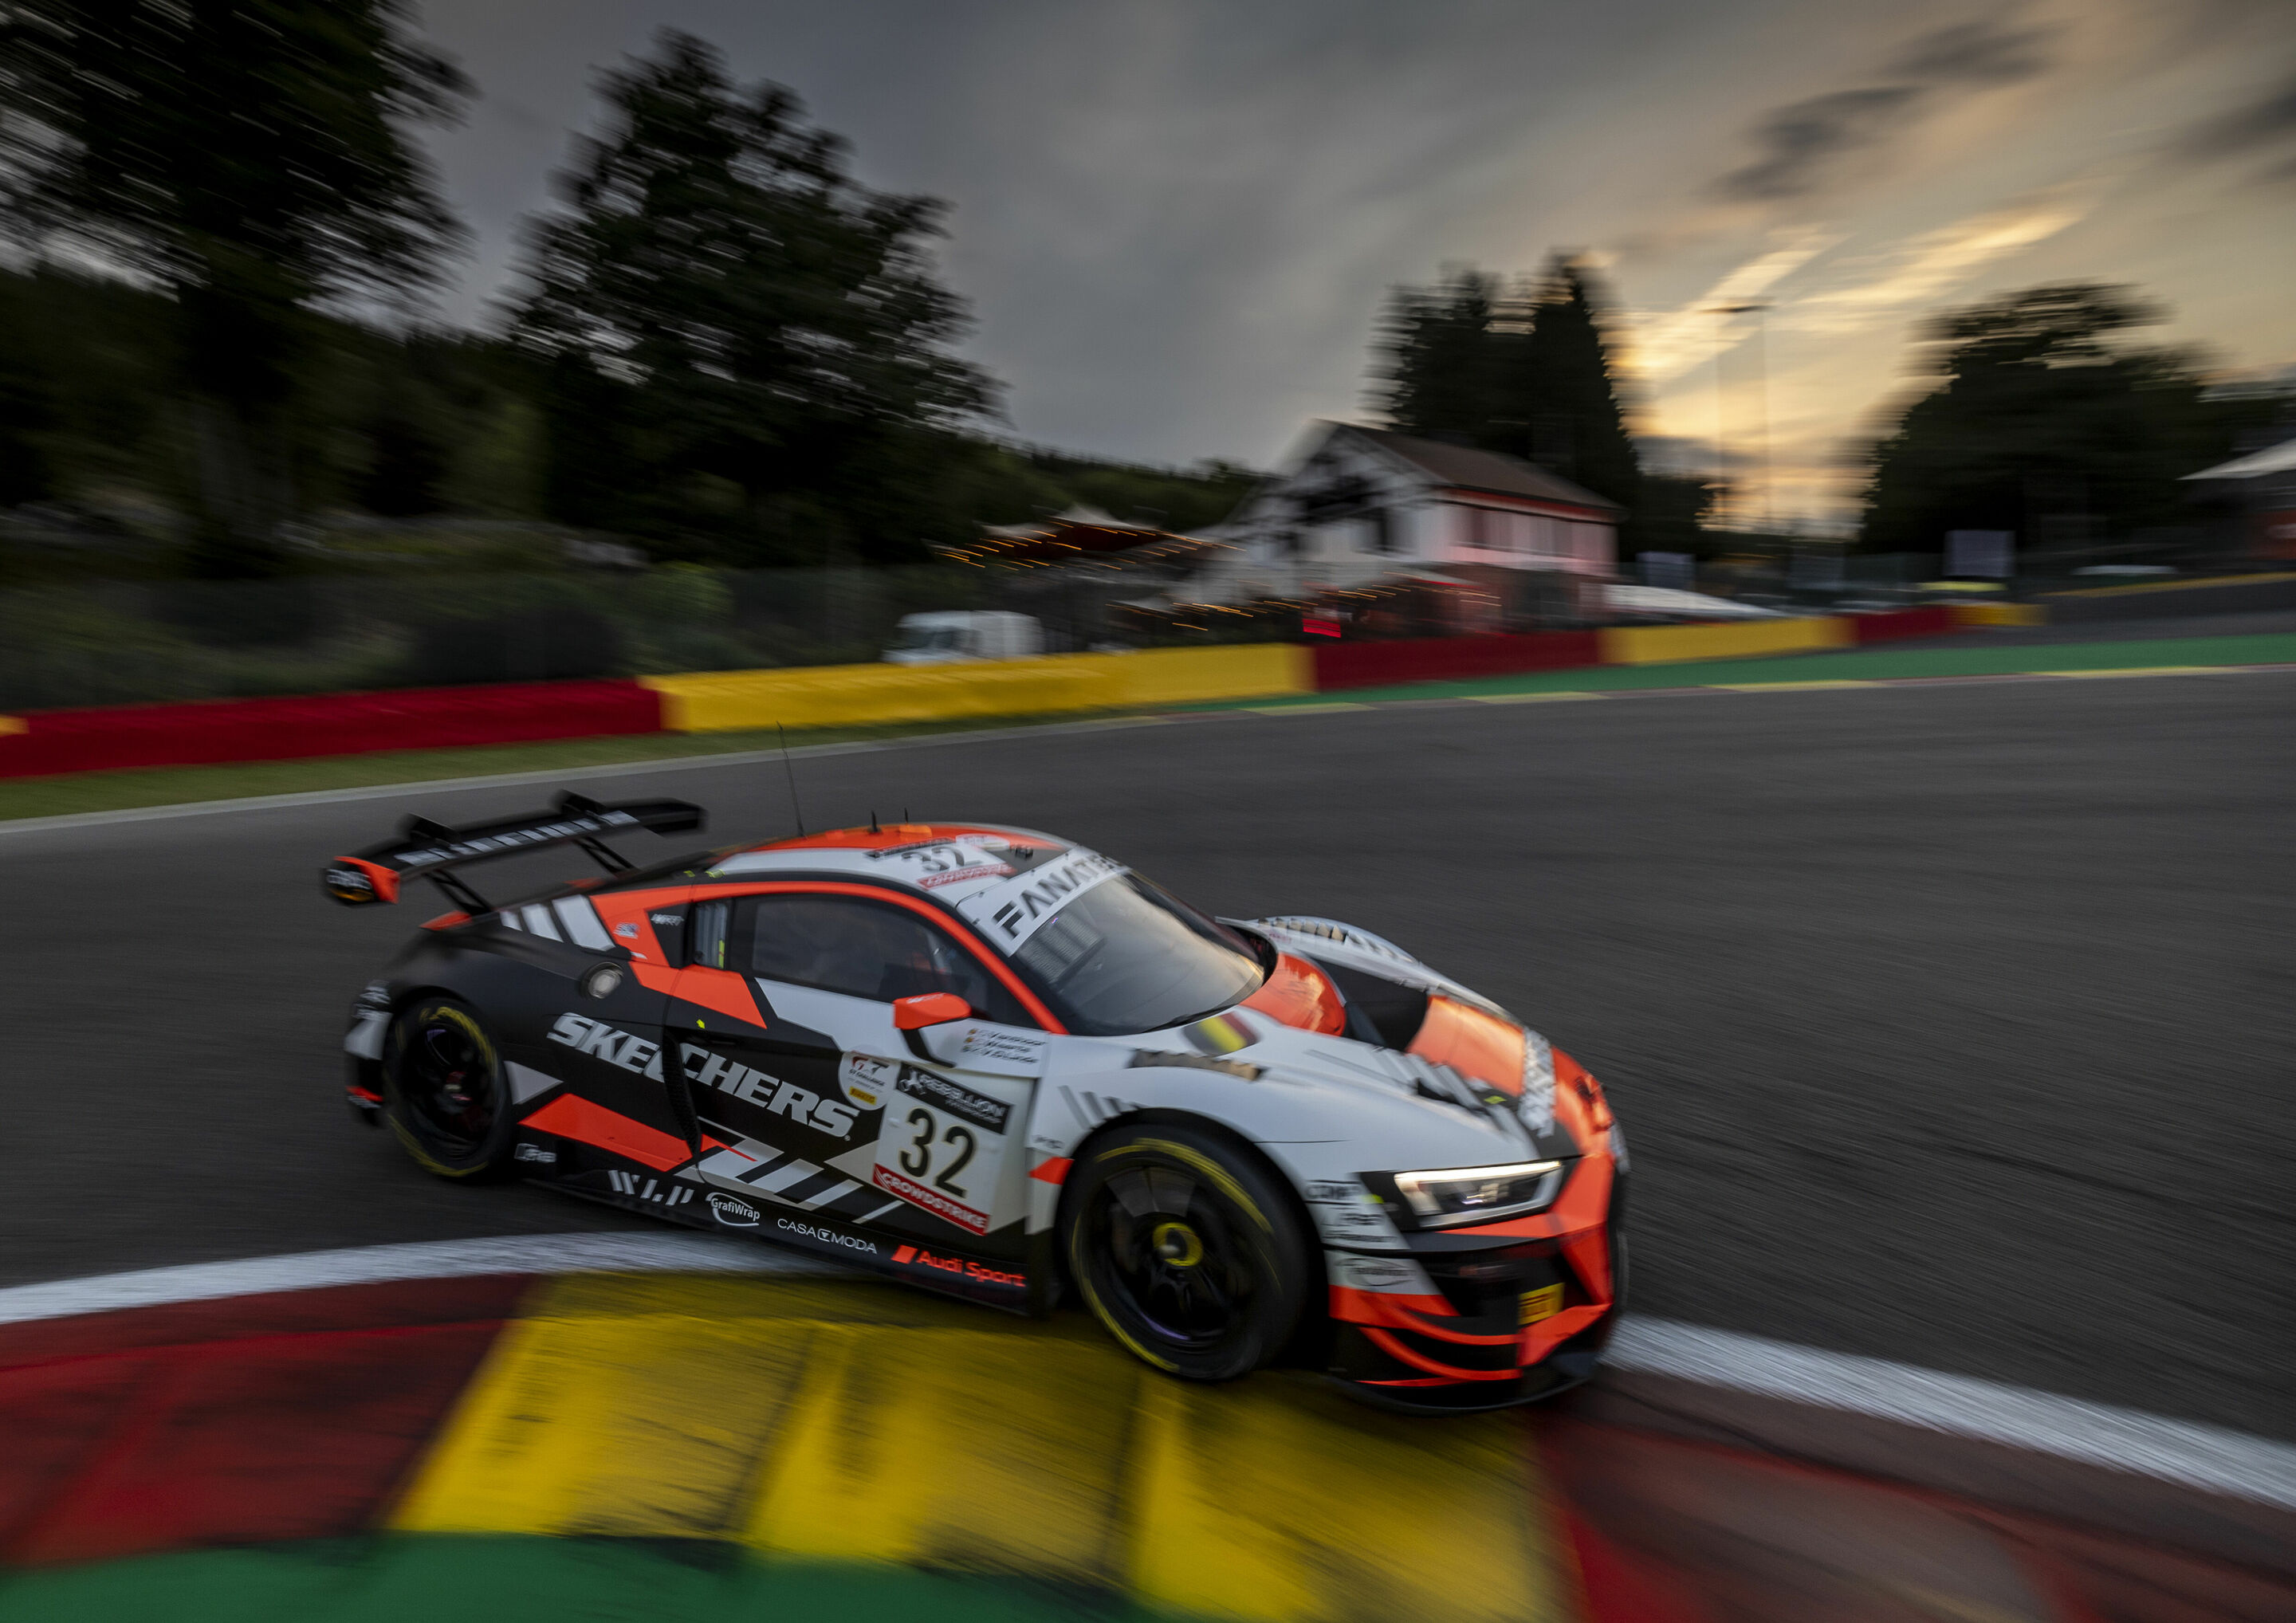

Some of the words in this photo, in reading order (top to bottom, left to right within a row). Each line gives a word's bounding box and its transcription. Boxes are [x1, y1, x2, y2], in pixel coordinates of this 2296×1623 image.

[902, 846, 983, 871] 32
[547, 1012, 860, 1138] SKECHERS
[899, 1107, 976, 1200] 32
[710, 1197, 761, 1222] GrafiWrap
[882, 1173, 988, 1229] CROWDSTRIKE
[916, 1250, 963, 1274] Audi
[965, 1262, 1027, 1287] Sport
